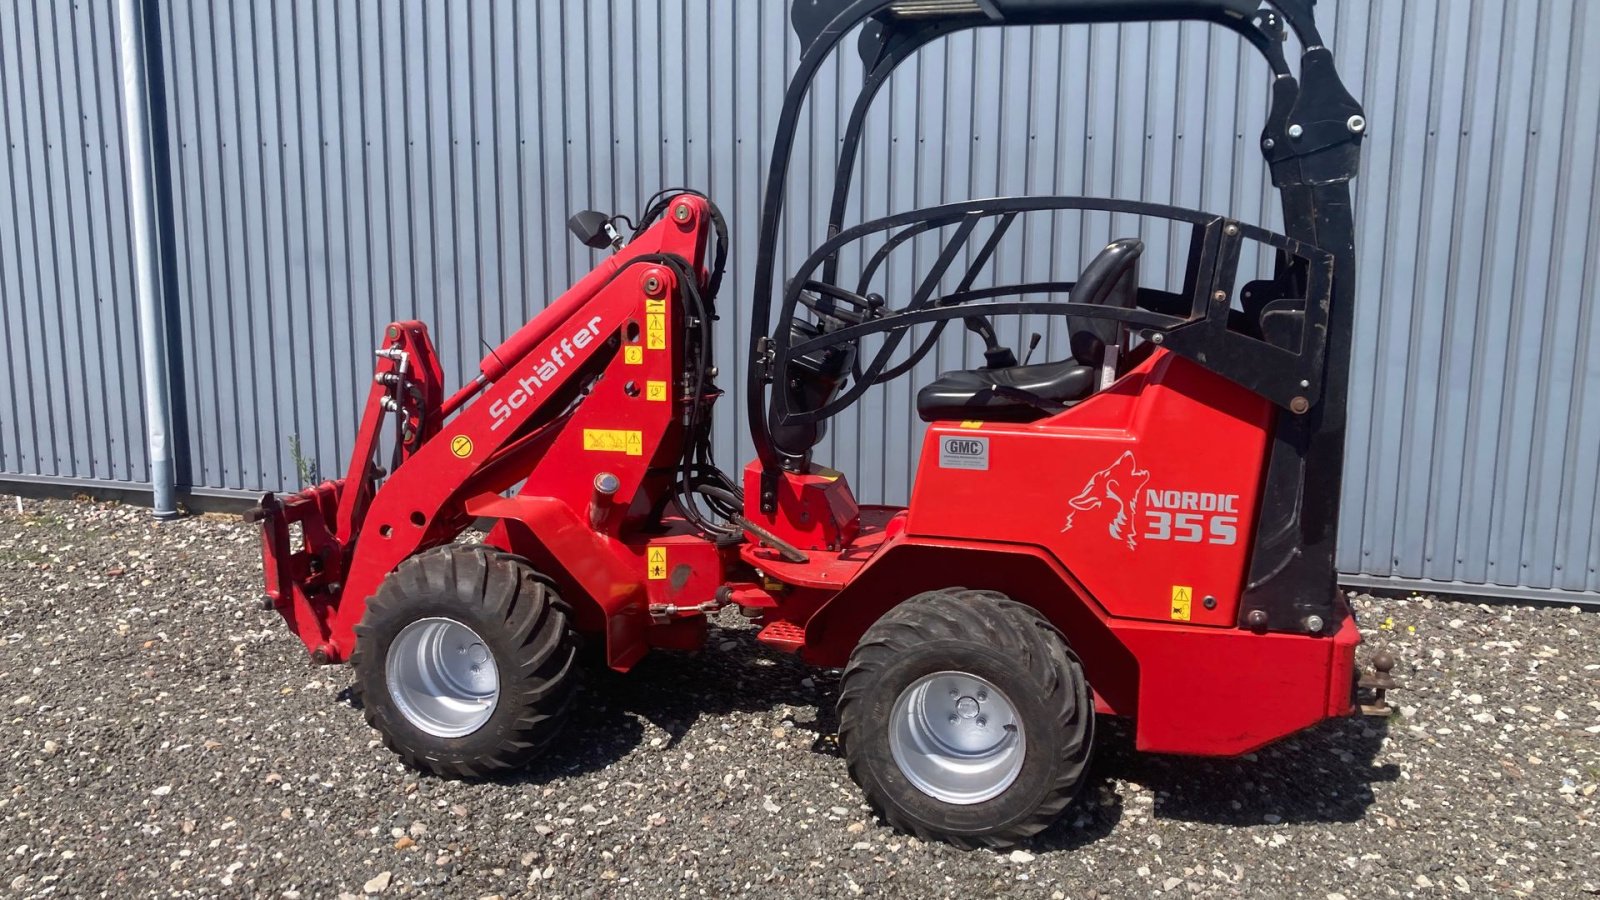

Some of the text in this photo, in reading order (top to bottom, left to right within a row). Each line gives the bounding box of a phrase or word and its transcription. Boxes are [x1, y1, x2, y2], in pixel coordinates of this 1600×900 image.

[489, 316, 602, 431] Schäffer
[950, 440, 979, 454] GMC
[1146, 489, 1239, 513] NORDIC
